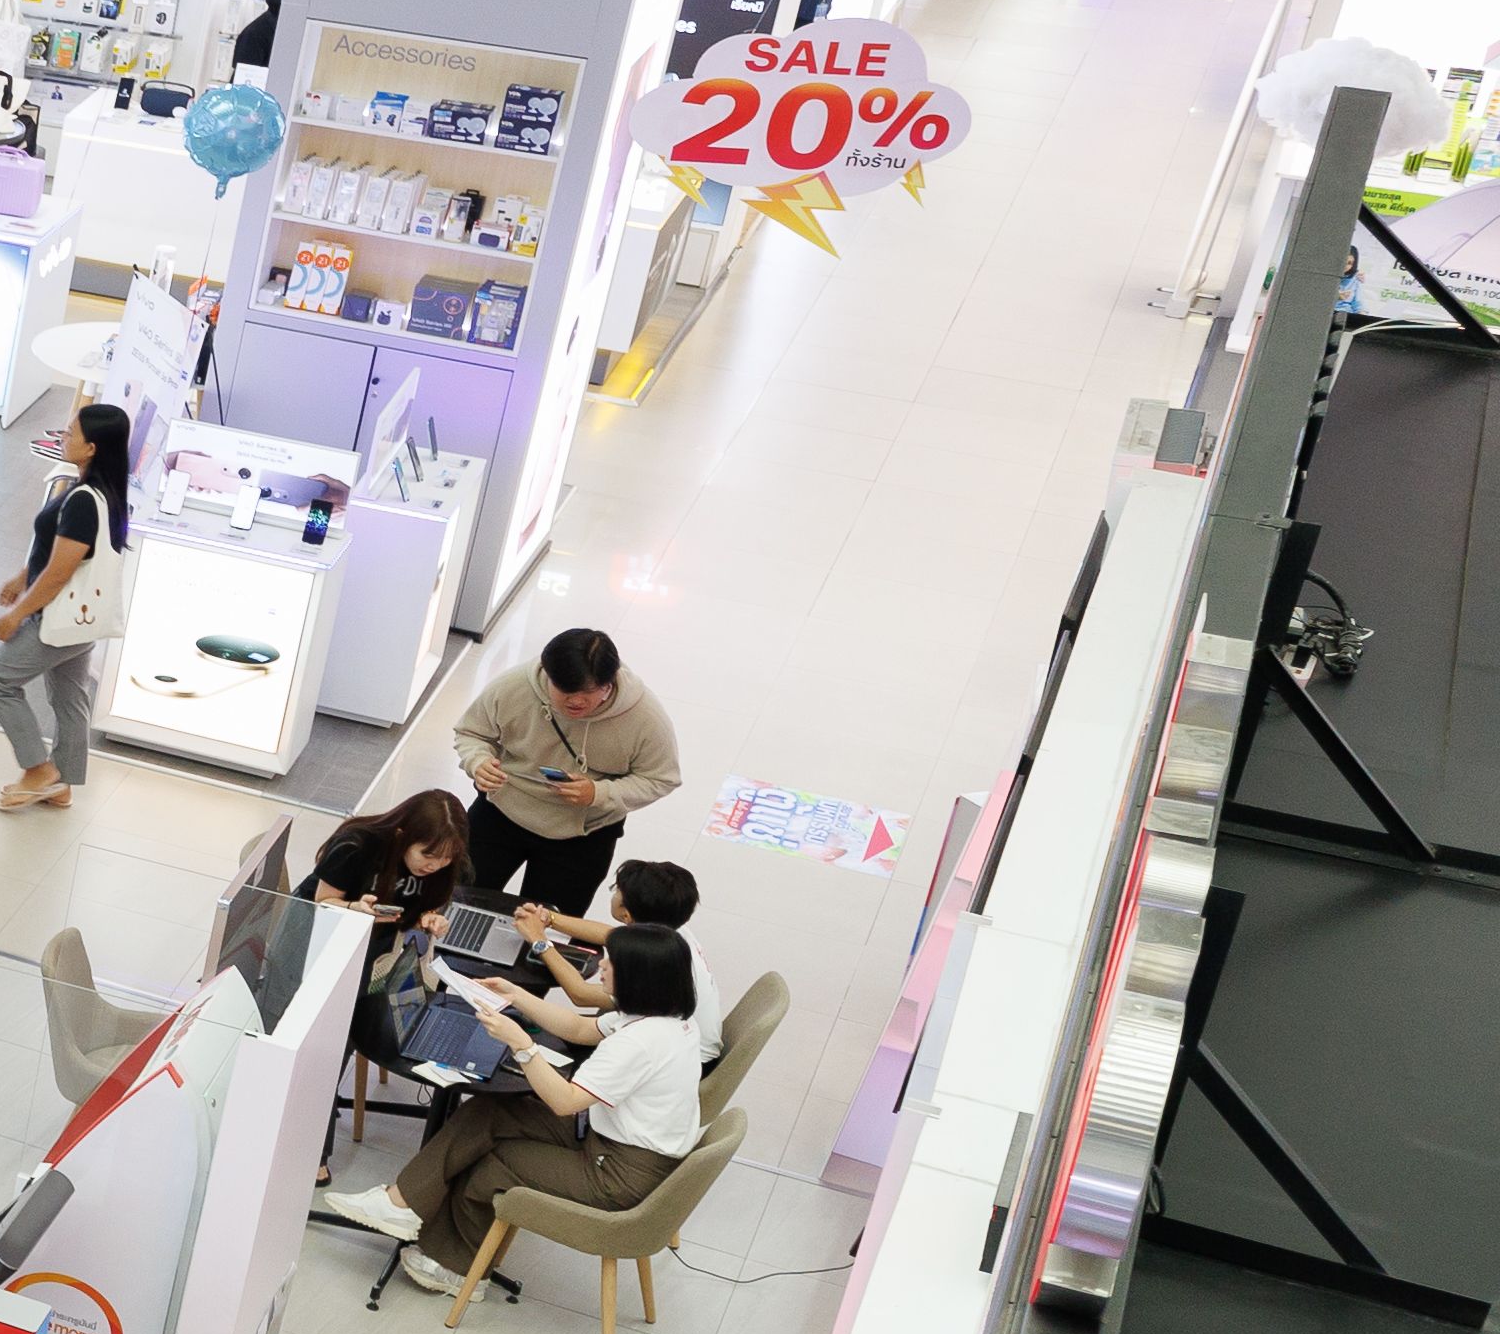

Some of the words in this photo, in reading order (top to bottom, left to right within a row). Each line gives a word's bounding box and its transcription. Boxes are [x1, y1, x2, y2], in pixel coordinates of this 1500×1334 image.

[335, 34, 476, 72] Accessories
[744, 37, 891, 78] SALE
[669, 76, 951, 172] 20%
[844, 147, 908, 173] ทั้งร้าน
